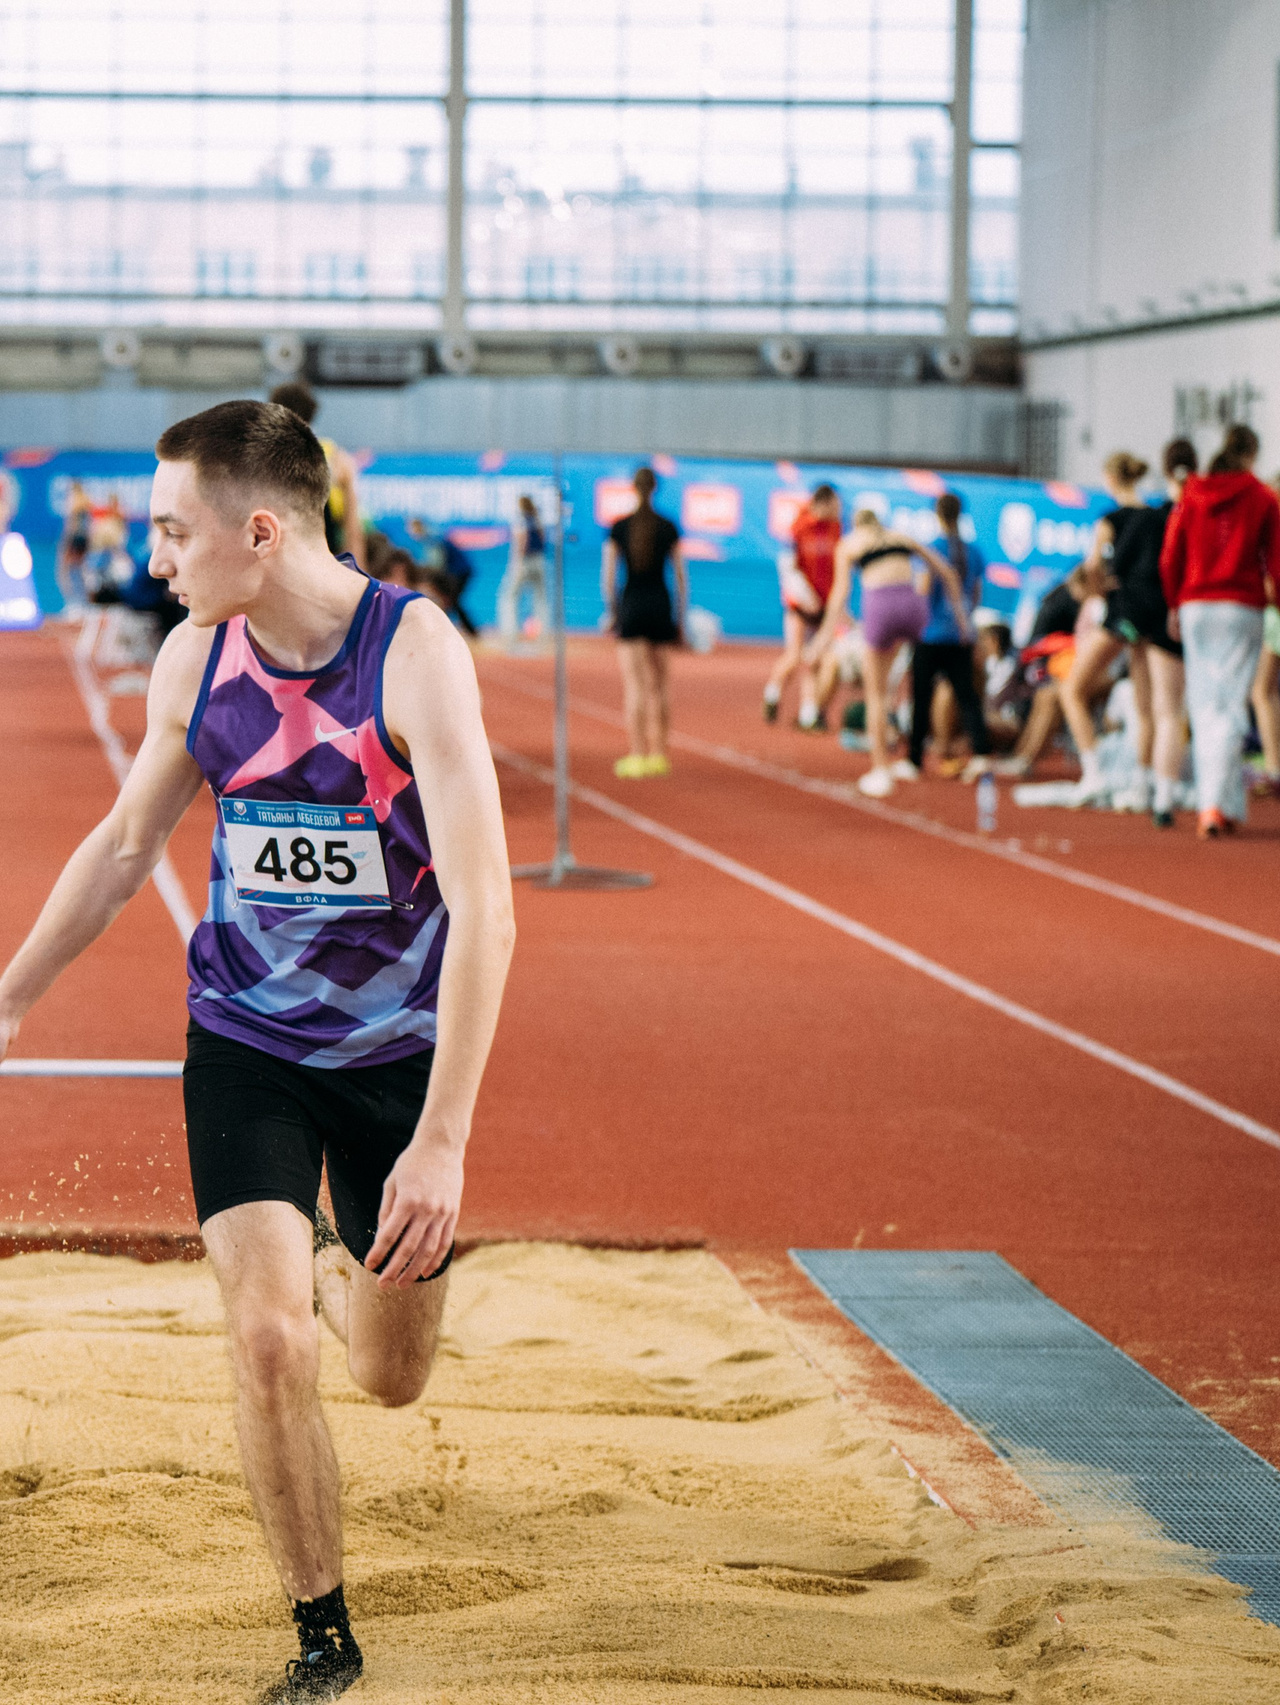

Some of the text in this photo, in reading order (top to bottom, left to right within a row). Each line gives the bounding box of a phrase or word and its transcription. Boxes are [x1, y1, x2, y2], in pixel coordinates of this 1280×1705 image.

[257, 811, 341, 826] ТАТЬЯНЫ ЛЕБЕДЕВОЙ
[254, 836, 357, 885] 485
[295, 895, 328, 904] ВФЛА
